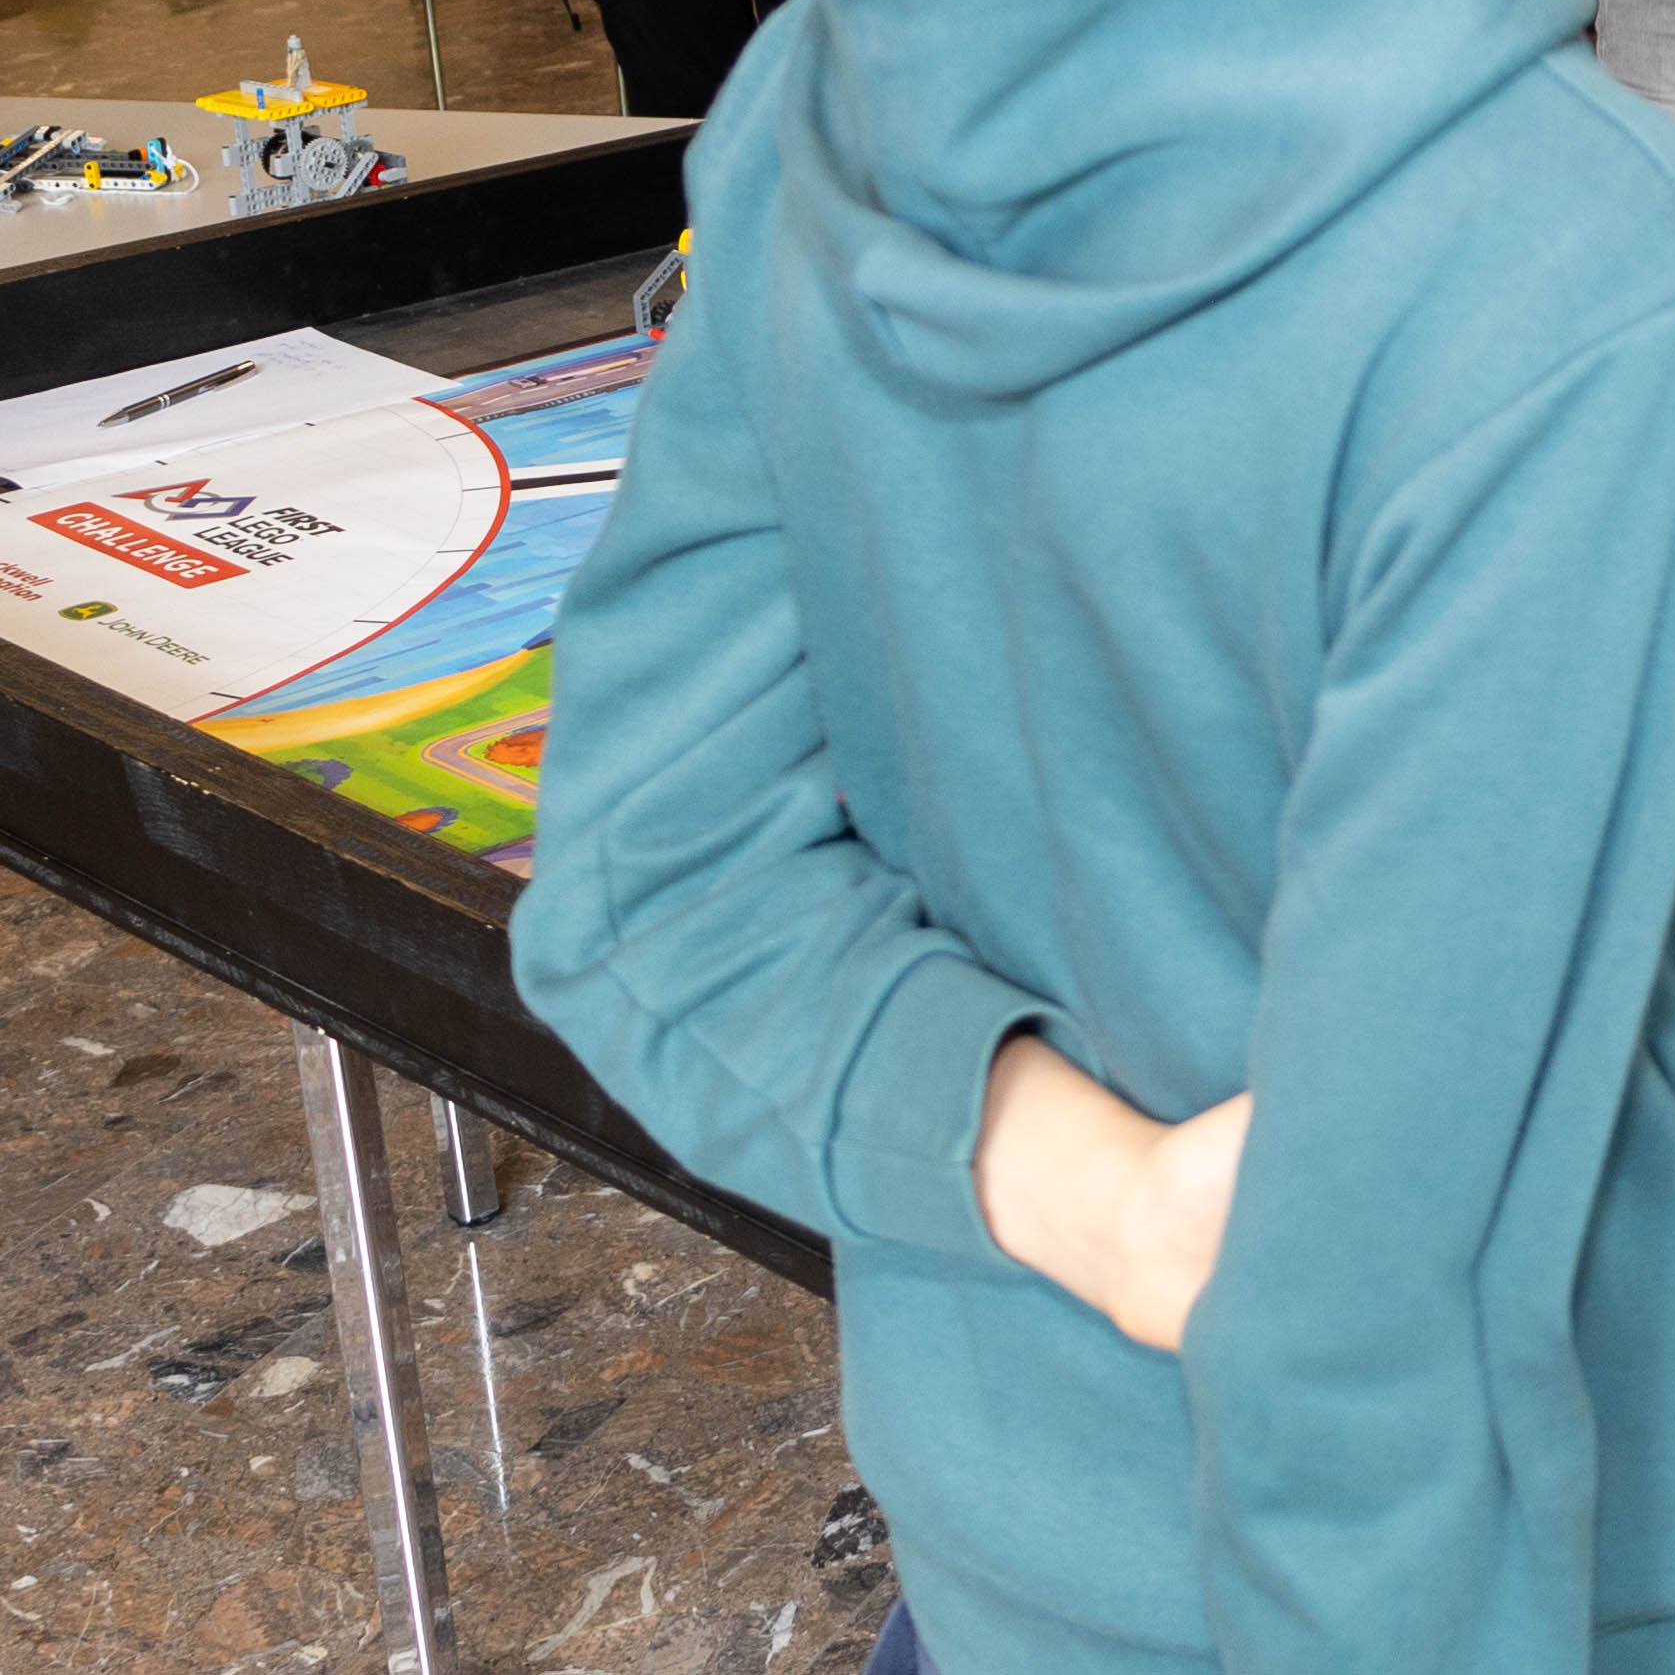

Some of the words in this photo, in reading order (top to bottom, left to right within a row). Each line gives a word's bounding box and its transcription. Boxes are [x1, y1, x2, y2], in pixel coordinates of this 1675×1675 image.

[227, 515, 300, 545] LEGO
[262, 506, 346, 536] FIRST
[56, 512, 219, 578] CHALLENGE
[192, 526, 295, 566] LEAGUE
[0, 562, 54, 587] ckwell
[97, 618, 155, 640] JOHN
[144, 635, 210, 665] DEERE
